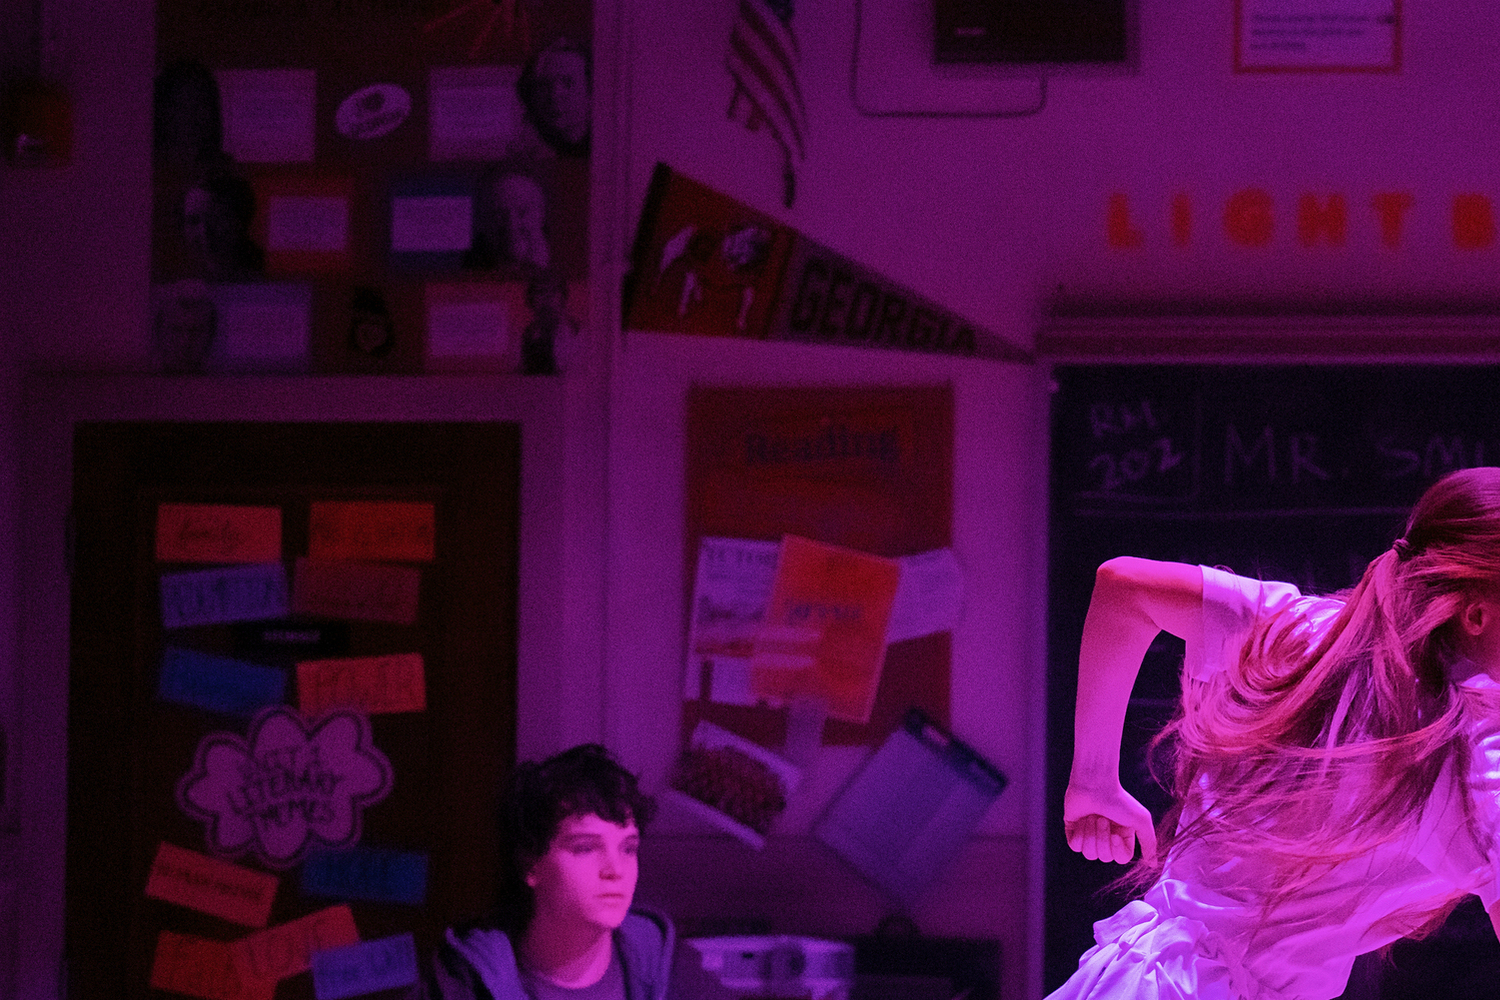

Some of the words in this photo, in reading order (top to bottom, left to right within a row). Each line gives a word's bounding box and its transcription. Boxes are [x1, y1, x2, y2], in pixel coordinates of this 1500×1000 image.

[1106, 187, 1414, 251] LIGHT
[790, 258, 977, 352] GEORGIA
[743, 425, 901, 468] Reading
[1088, 436, 1187, 490] 202
